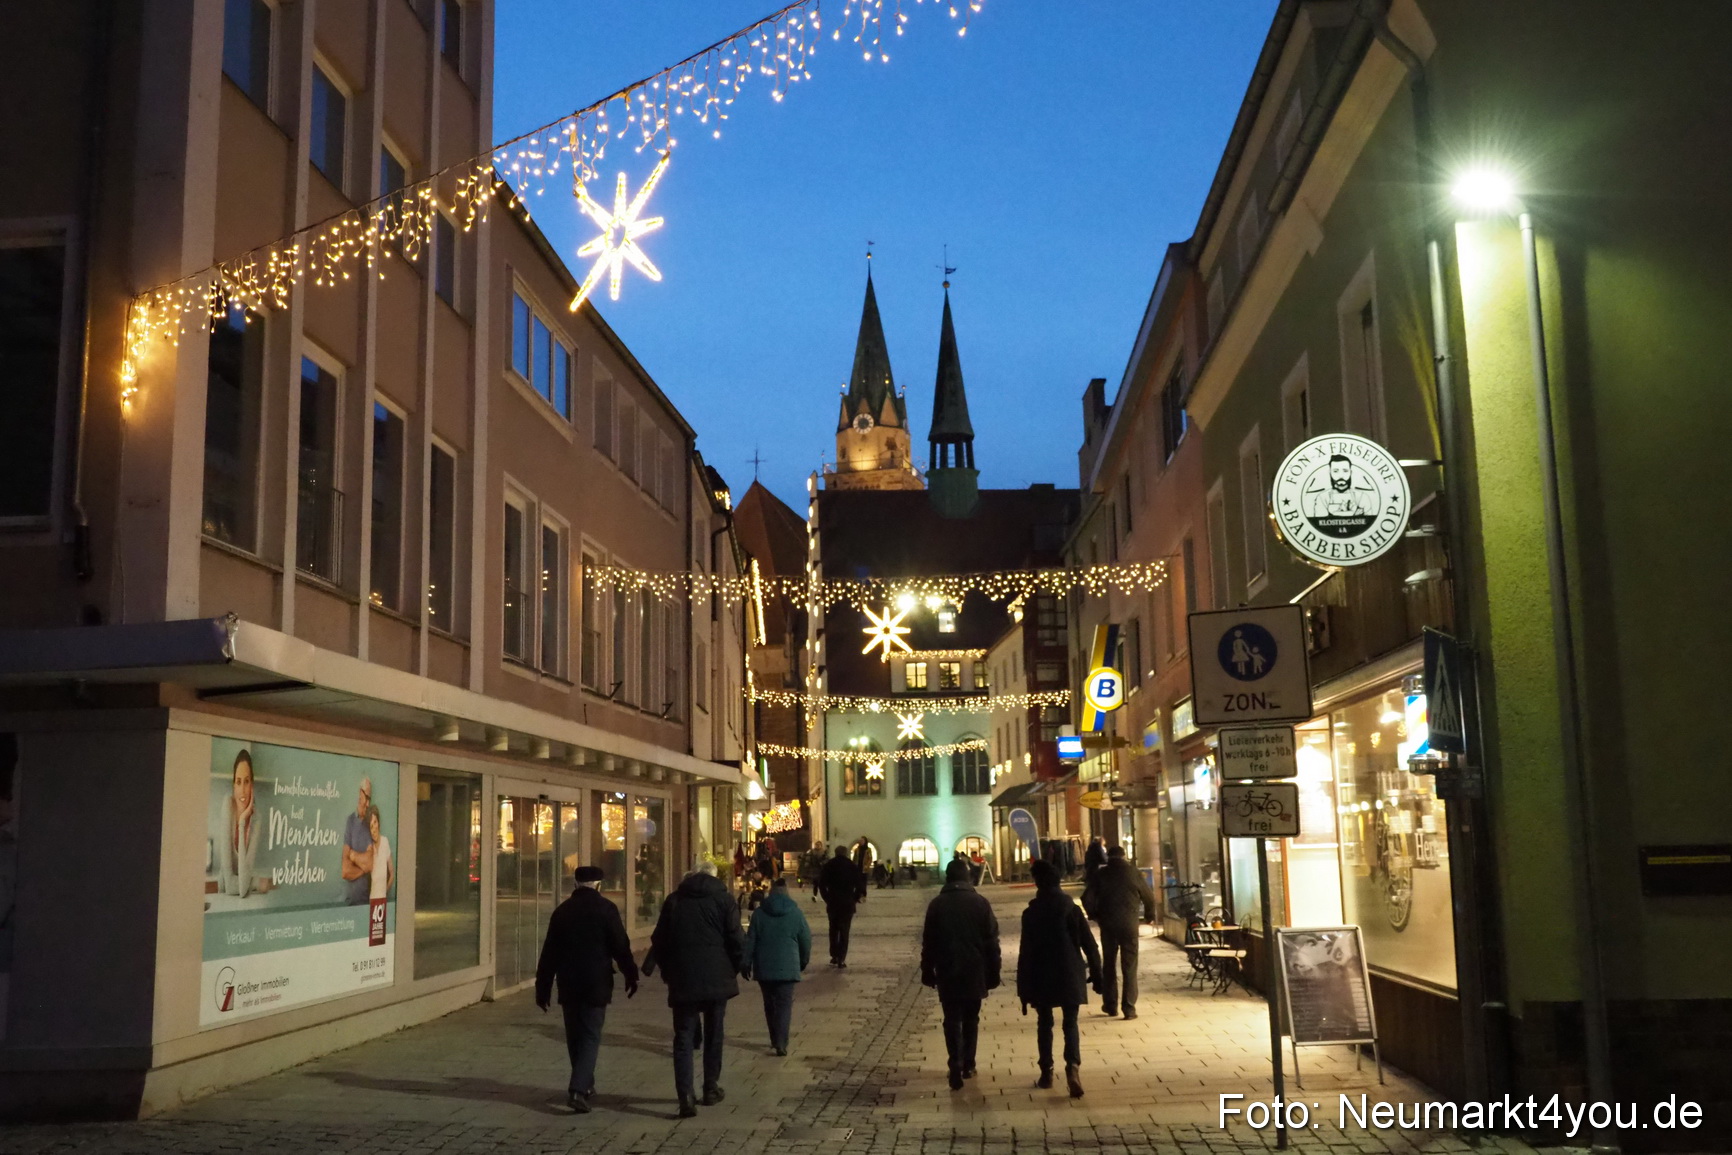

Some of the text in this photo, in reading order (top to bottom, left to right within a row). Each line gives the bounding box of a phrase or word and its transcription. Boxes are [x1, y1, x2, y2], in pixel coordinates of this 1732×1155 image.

[1329, 442, 1396, 484] FRISEURE
[1283, 505, 1401, 559] BARBERSHOP
[1318, 518, 1367, 527] KLOSTERGASSE
[1097, 678, 1116, 698] B
[1249, 761, 1269, 773] frei
[274, 776, 340, 800] Immobilien vermitteln
[269, 806, 339, 851] Menschen
[1248, 818, 1272, 831] frei
[272, 850, 327, 887] verstehen
[226, 917, 355, 945] Verkauf Vermietung Wertermittlung
[260, 976, 290, 991] Immobilien
